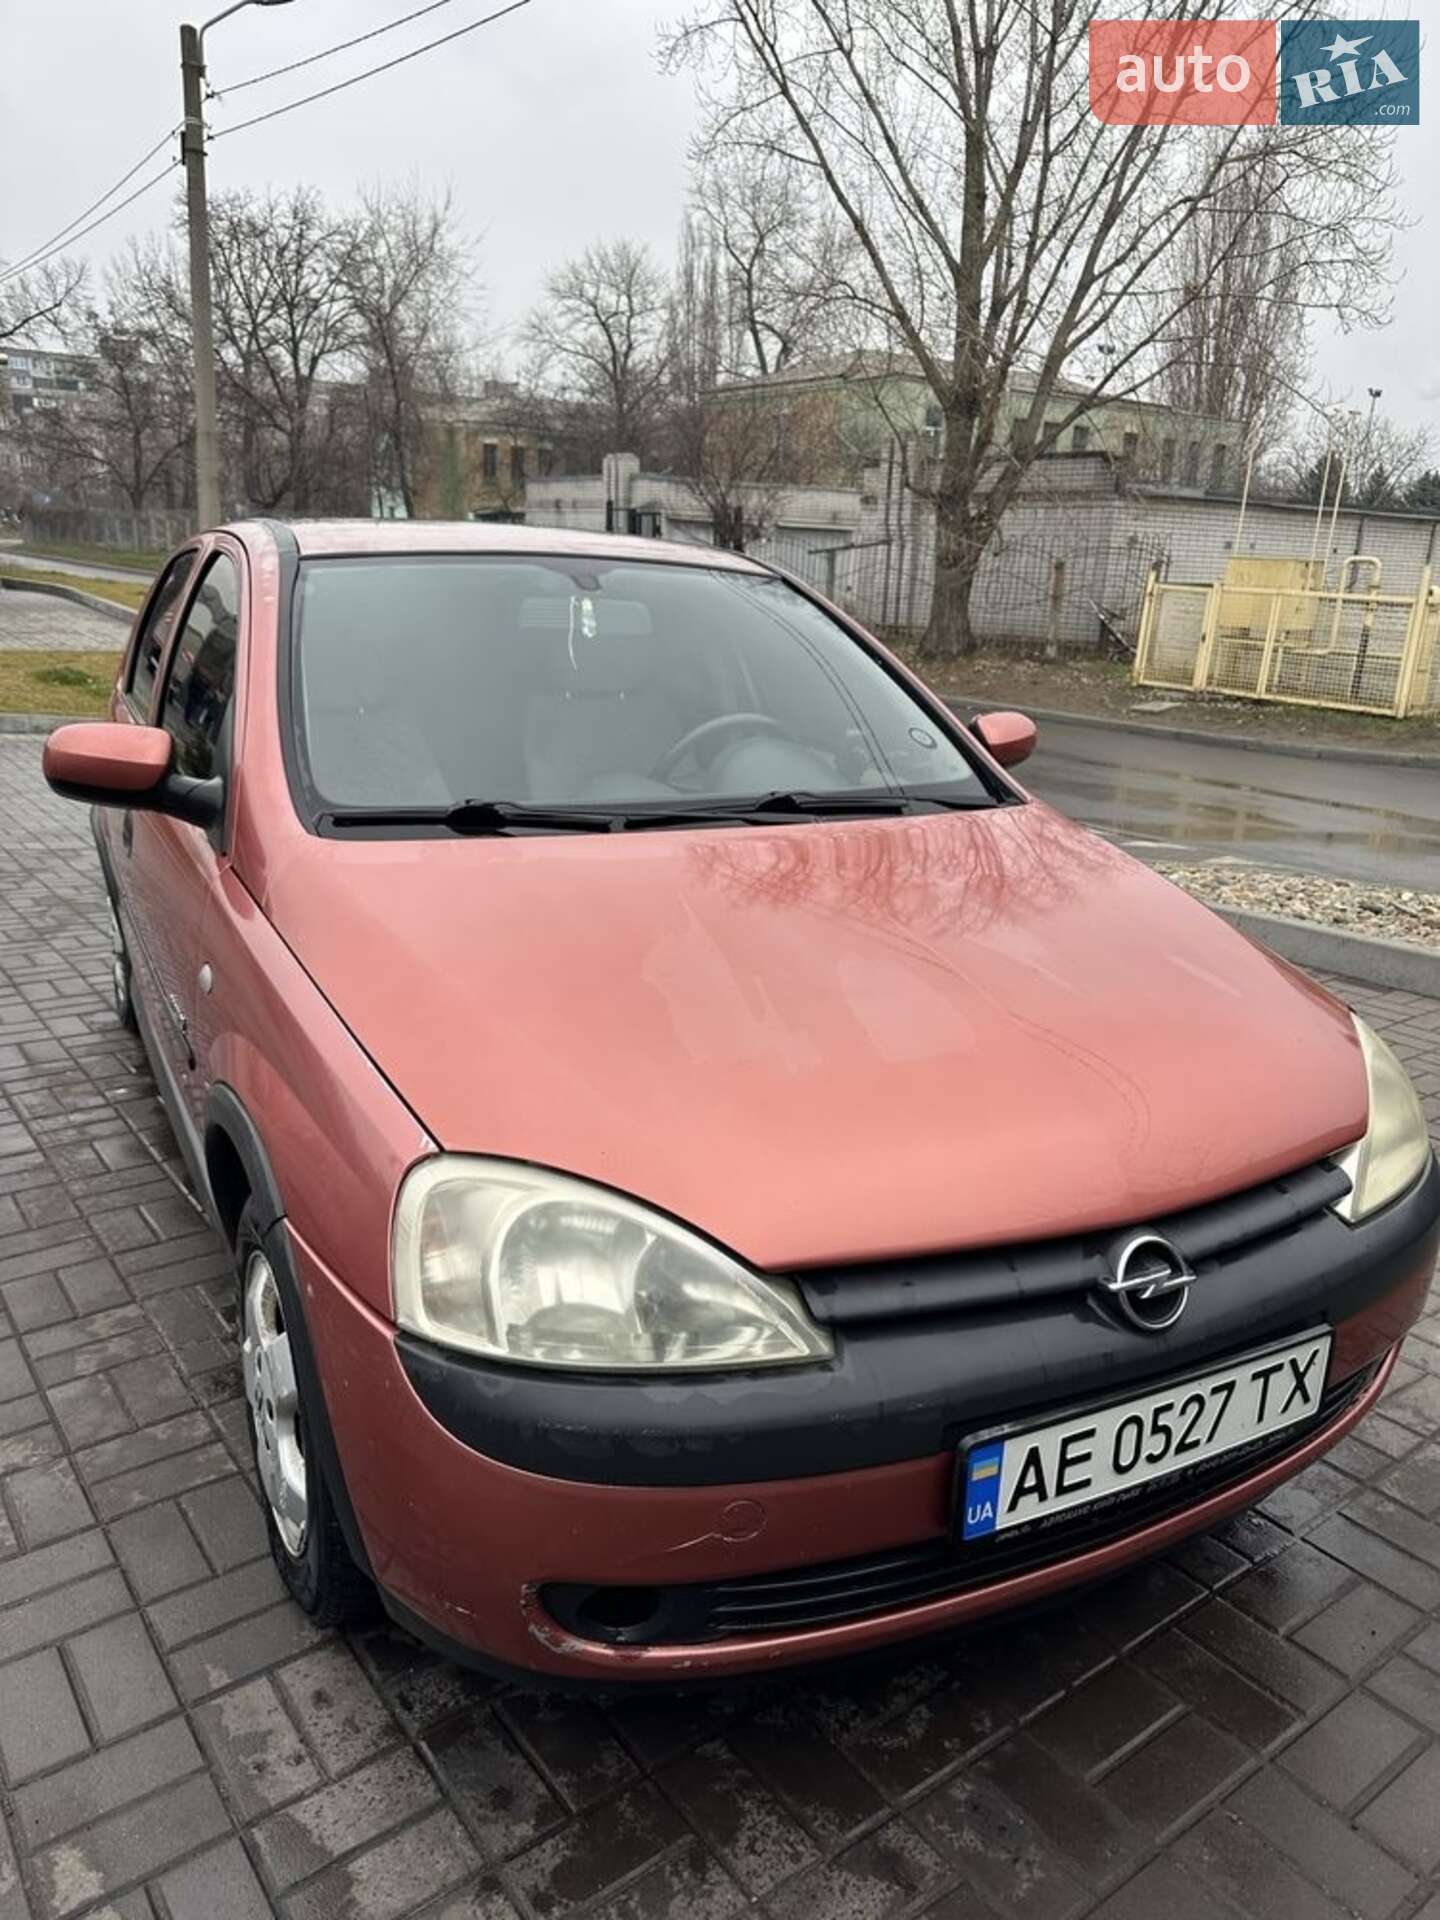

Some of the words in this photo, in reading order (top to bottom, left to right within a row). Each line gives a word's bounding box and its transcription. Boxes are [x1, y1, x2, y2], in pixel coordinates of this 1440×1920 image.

[1006, 1427, 1097, 1514] AE
[1112, 1379, 1237, 1475] 0527
[1251, 1348, 1320, 1424] TX
[967, 1501, 993, 1524] UA
